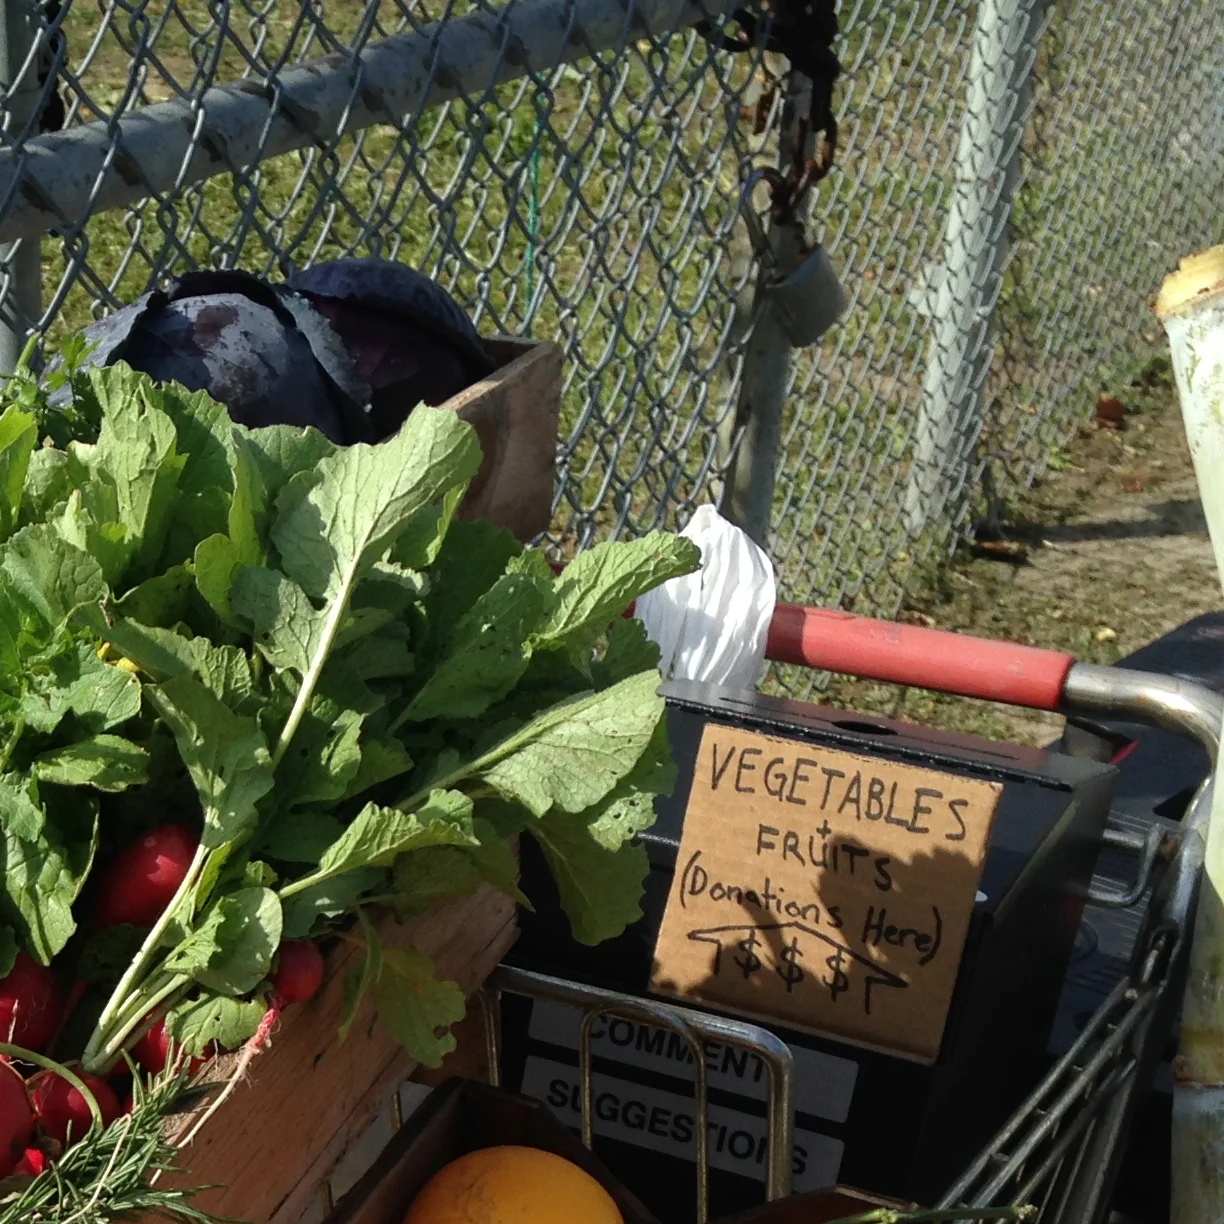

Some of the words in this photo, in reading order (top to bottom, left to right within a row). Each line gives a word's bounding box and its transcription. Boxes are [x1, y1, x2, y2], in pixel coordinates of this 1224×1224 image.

[711, 743, 969, 841] VEGETABLES
[757, 824, 893, 892] FRUITS
[680, 850, 843, 929] (Donations
[861, 905, 943, 965] Here)
[587, 1013, 772, 1083] COMMENT
[547, 1079, 808, 1175] SGGESIOS
